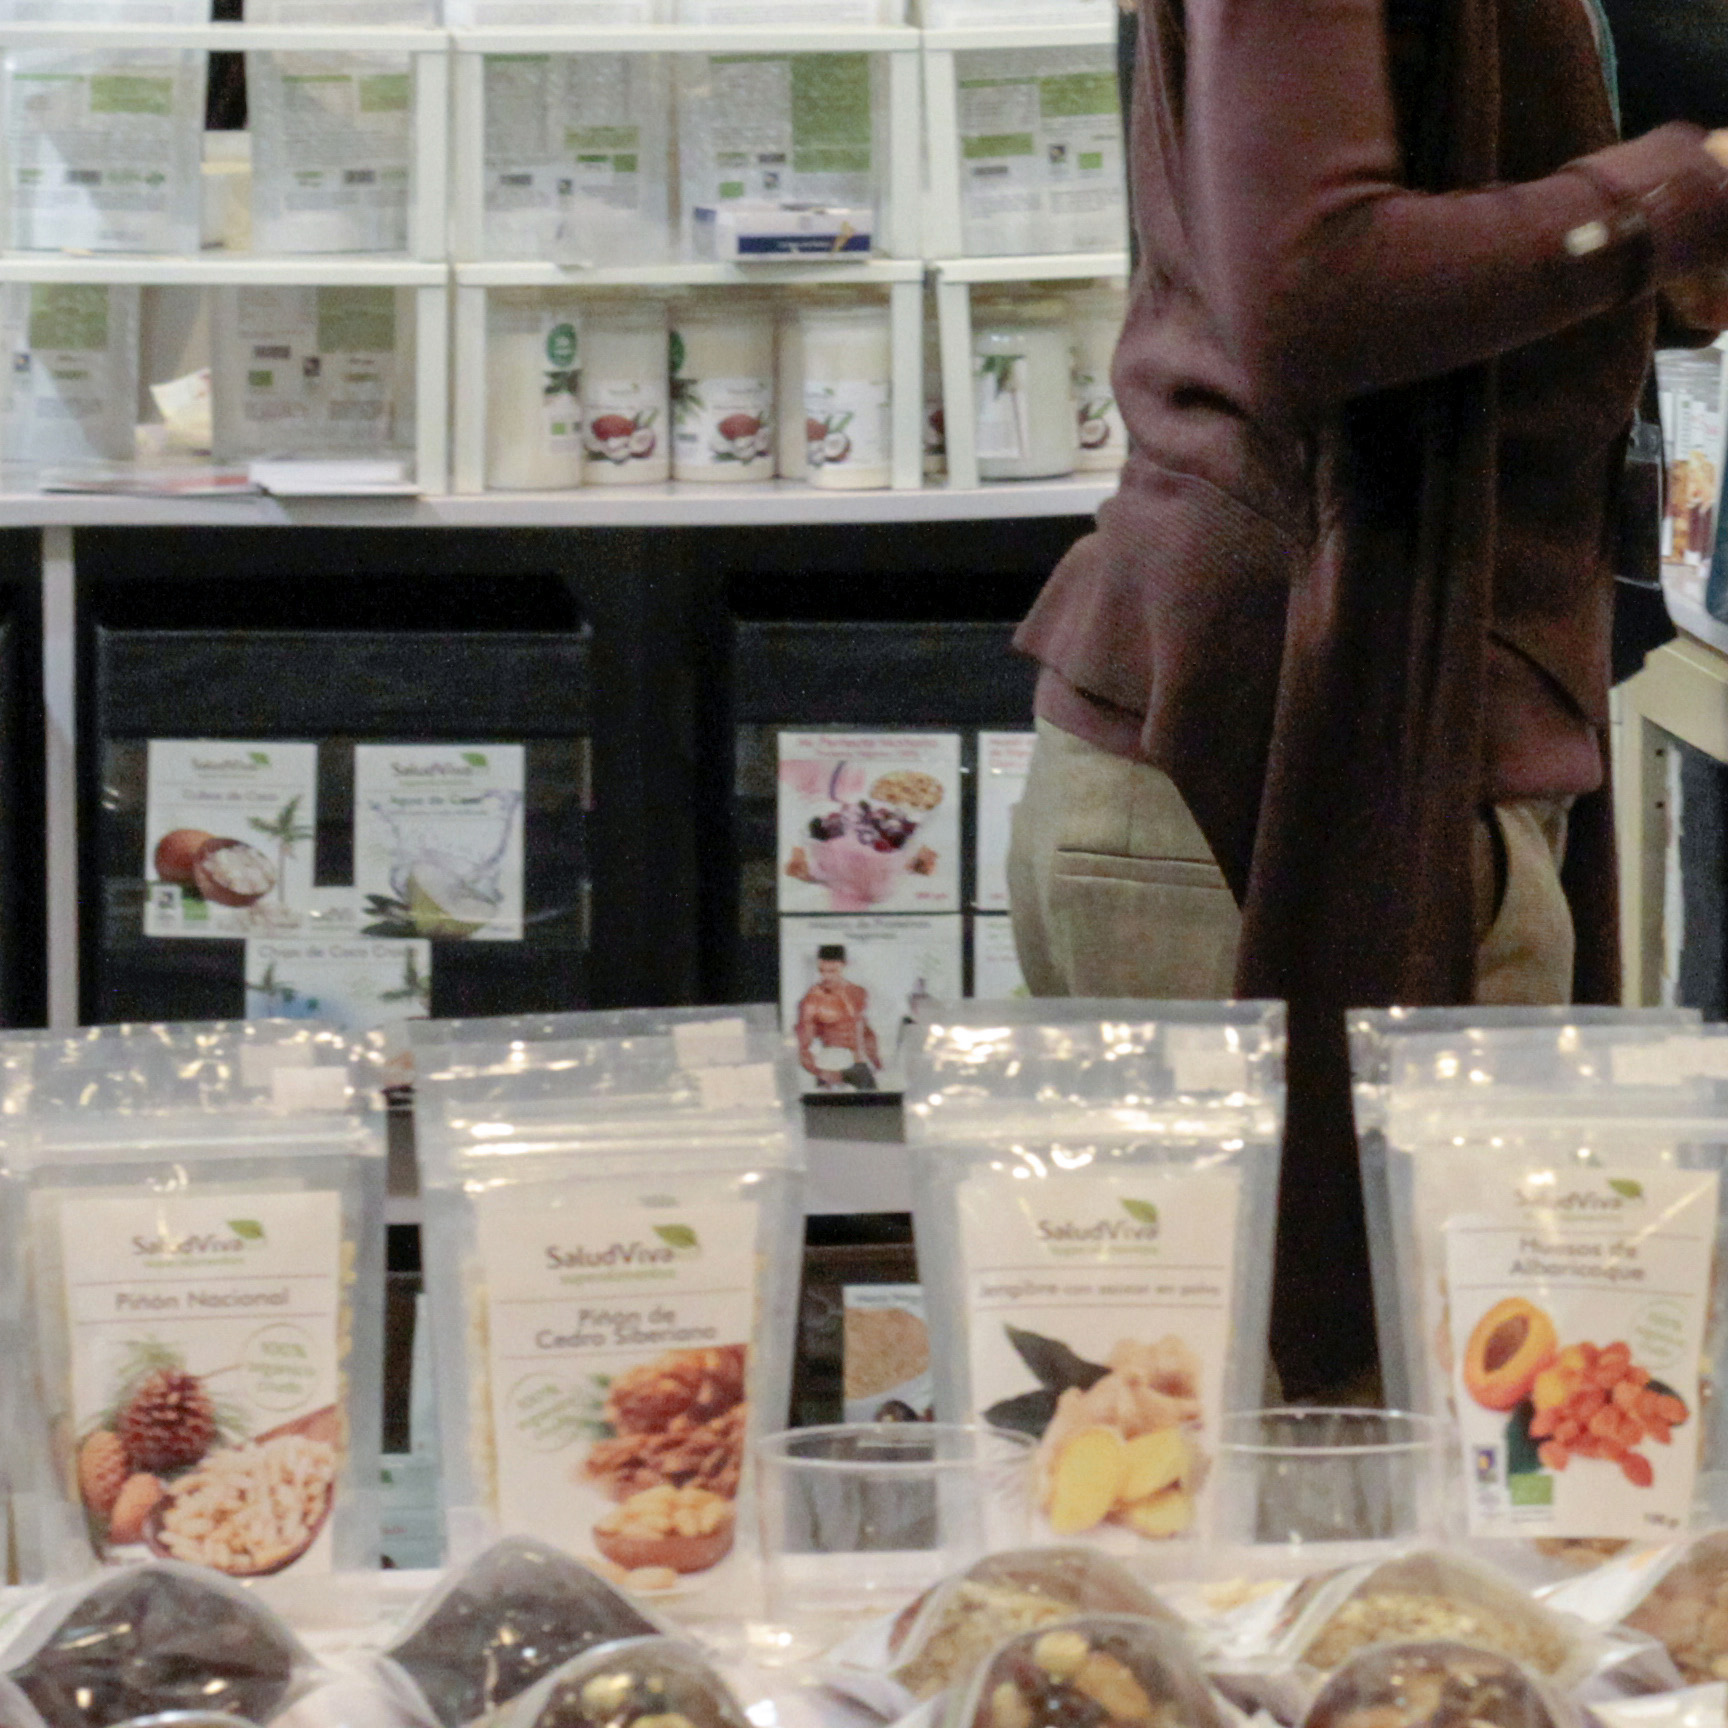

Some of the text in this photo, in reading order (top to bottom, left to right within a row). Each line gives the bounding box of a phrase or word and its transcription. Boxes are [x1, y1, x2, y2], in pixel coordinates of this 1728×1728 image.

[1037, 1218, 1160, 1241] SaludViva
[545, 1240, 676, 1270] SaludViva
[186, 1286, 291, 1309] Nacional
[647, 1305, 677, 1324] de
